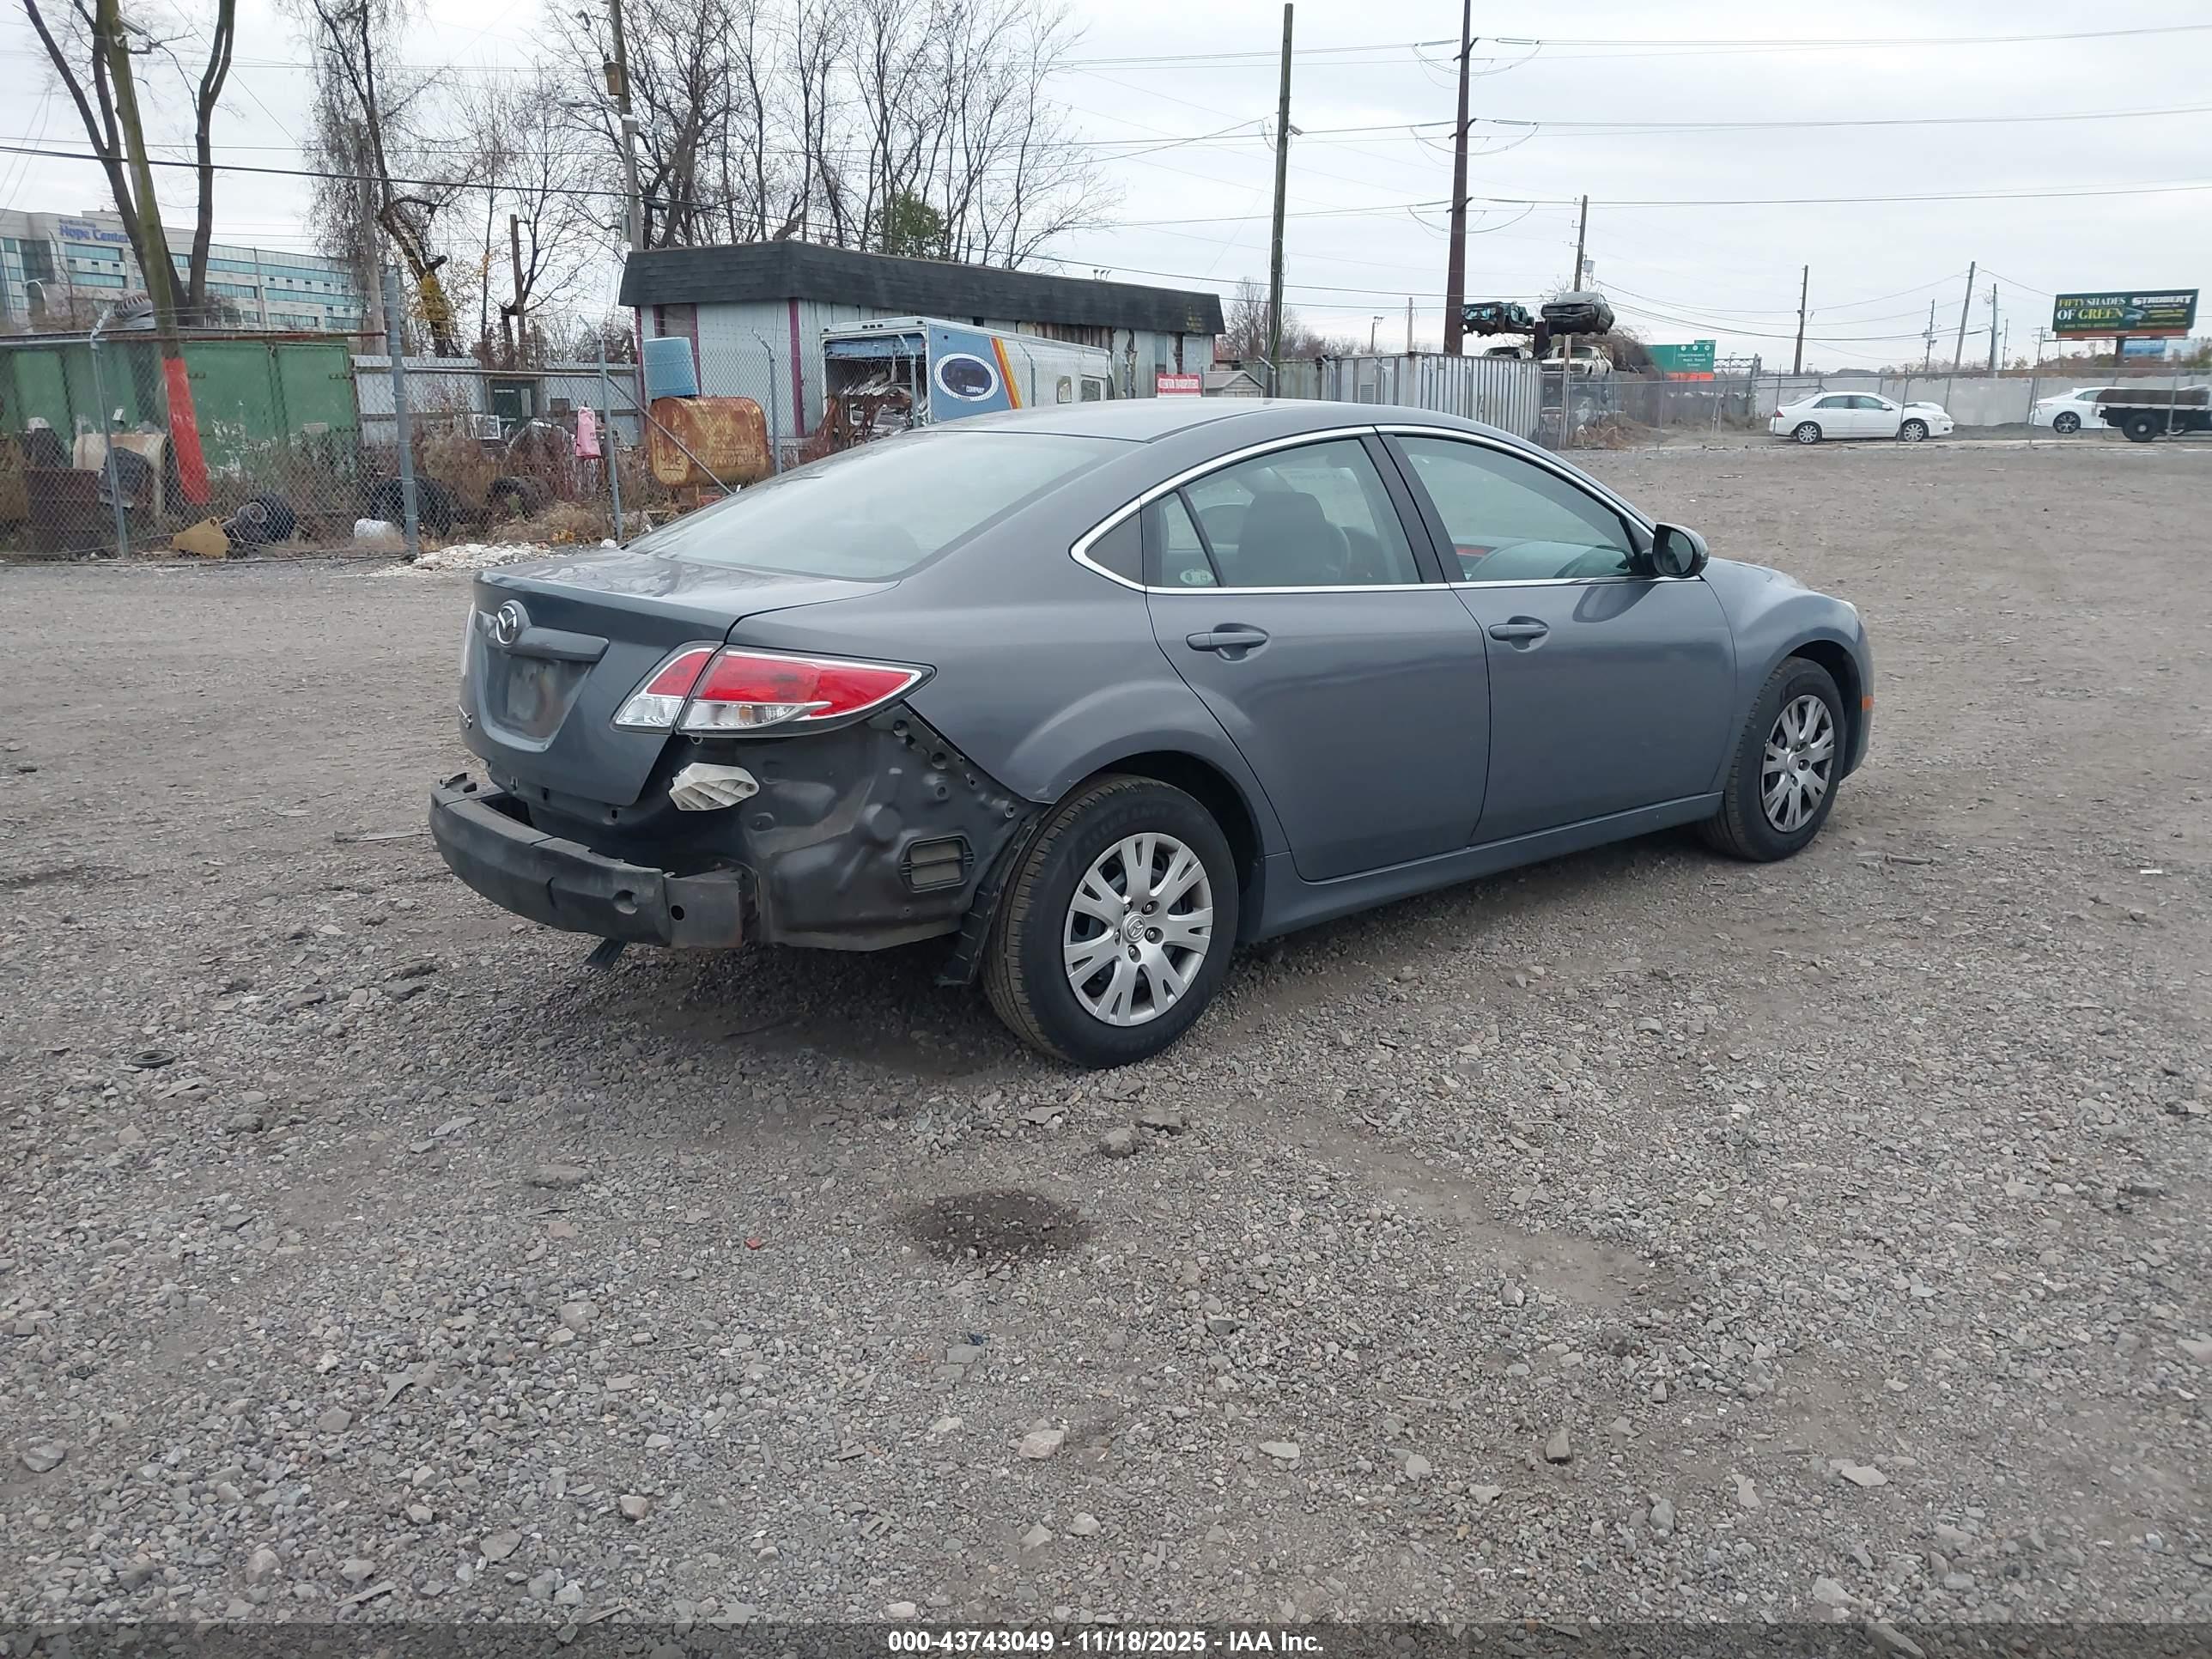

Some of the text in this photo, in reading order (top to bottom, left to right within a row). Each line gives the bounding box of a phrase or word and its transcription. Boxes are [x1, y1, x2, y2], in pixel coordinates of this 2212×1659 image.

[59, 224, 90, 240] Hope
[2059, 296, 2126, 307] FIFTY SHADES
[2057, 307, 2124, 320] OF GREEN
